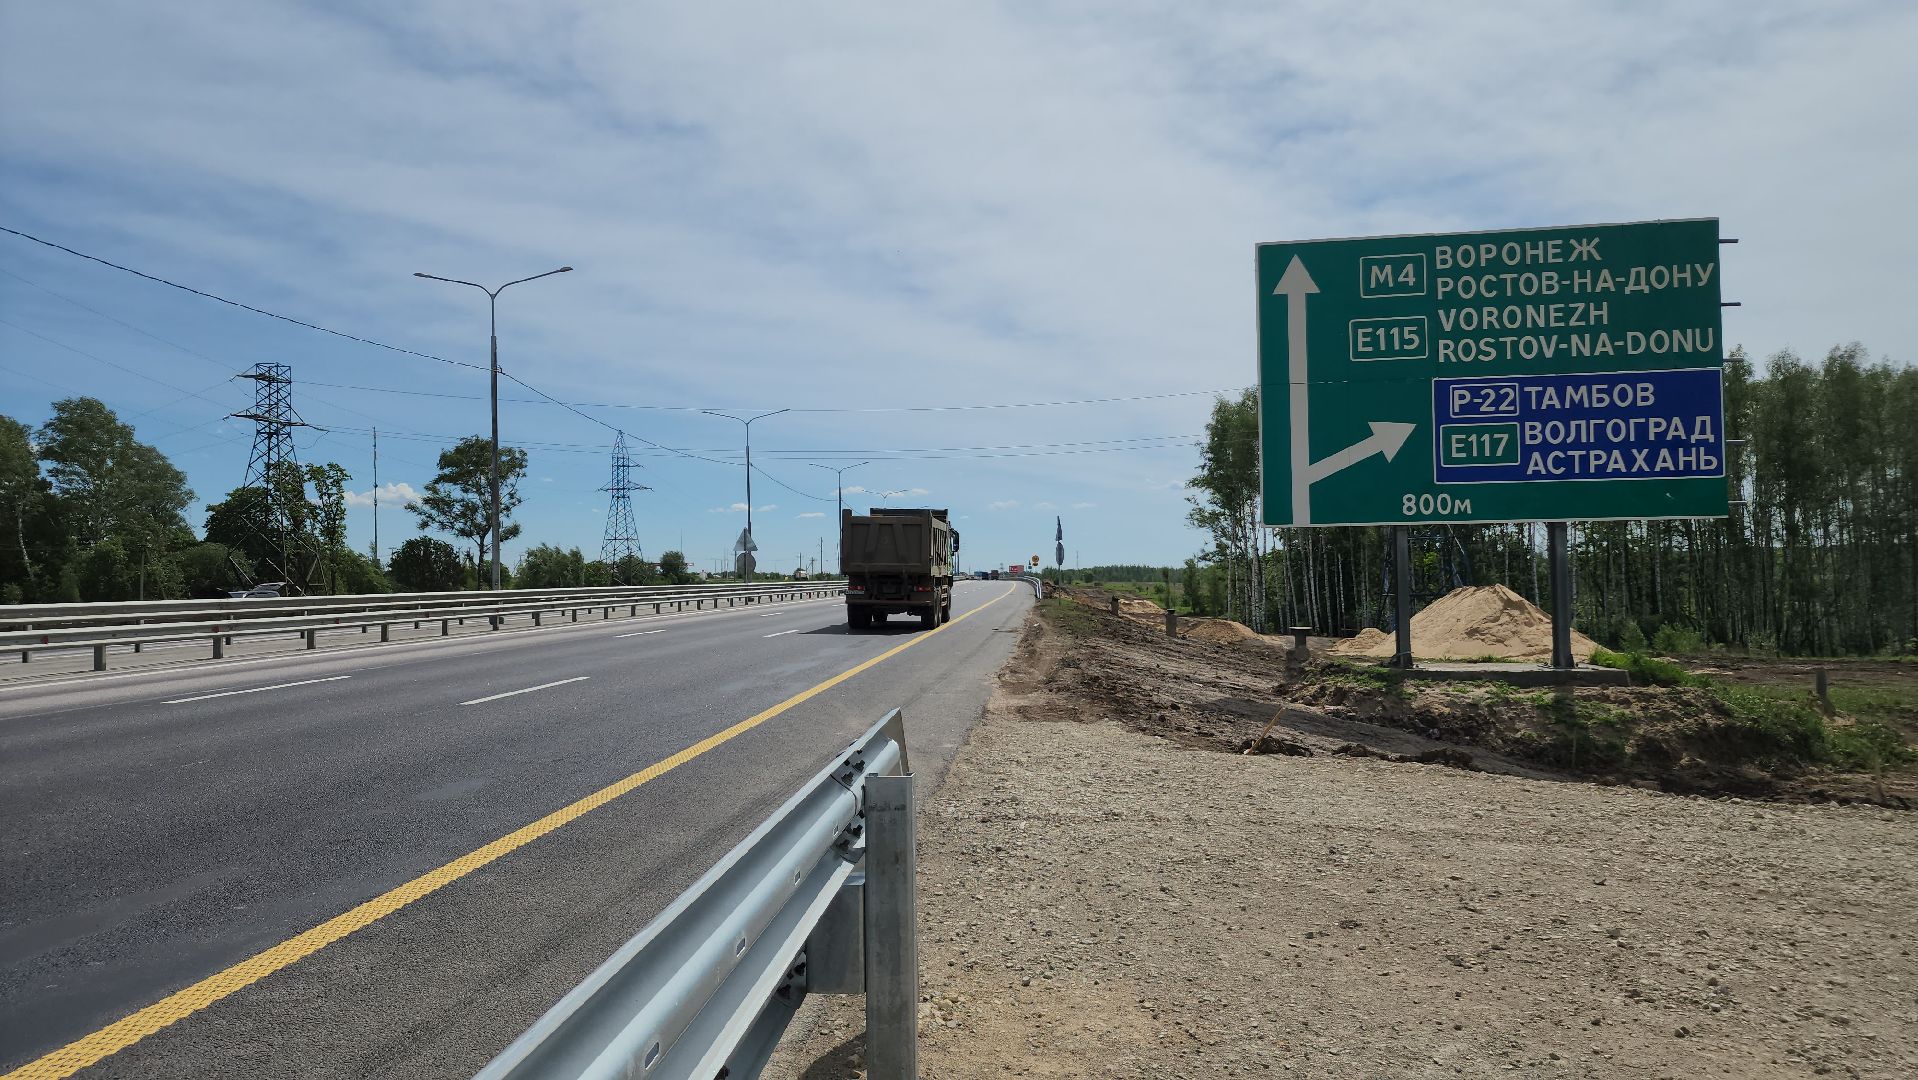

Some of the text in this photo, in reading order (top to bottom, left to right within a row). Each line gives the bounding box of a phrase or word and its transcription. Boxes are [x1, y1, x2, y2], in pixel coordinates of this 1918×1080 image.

[1436, 238, 1602, 270] ВОРОНЕЖ
[1370, 264, 1416, 289] М4
[1437, 263, 1714, 300] РОСТОВ-НА-ДОНУ
[1438, 302, 1608, 331] VORONEZH
[1357, 327, 1419, 352] E115
[1438, 328, 1714, 363] ROSTOV-NA-DONU
[1453, 388, 1515, 412] Р-22
[1523, 383, 1655, 410] ТАМБОВ
[1525, 416, 1715, 445] ВОЛГОГРАД
[1451, 433, 1509, 458] E117
[1526, 447, 1718, 475] АСТРАХАНЬ
